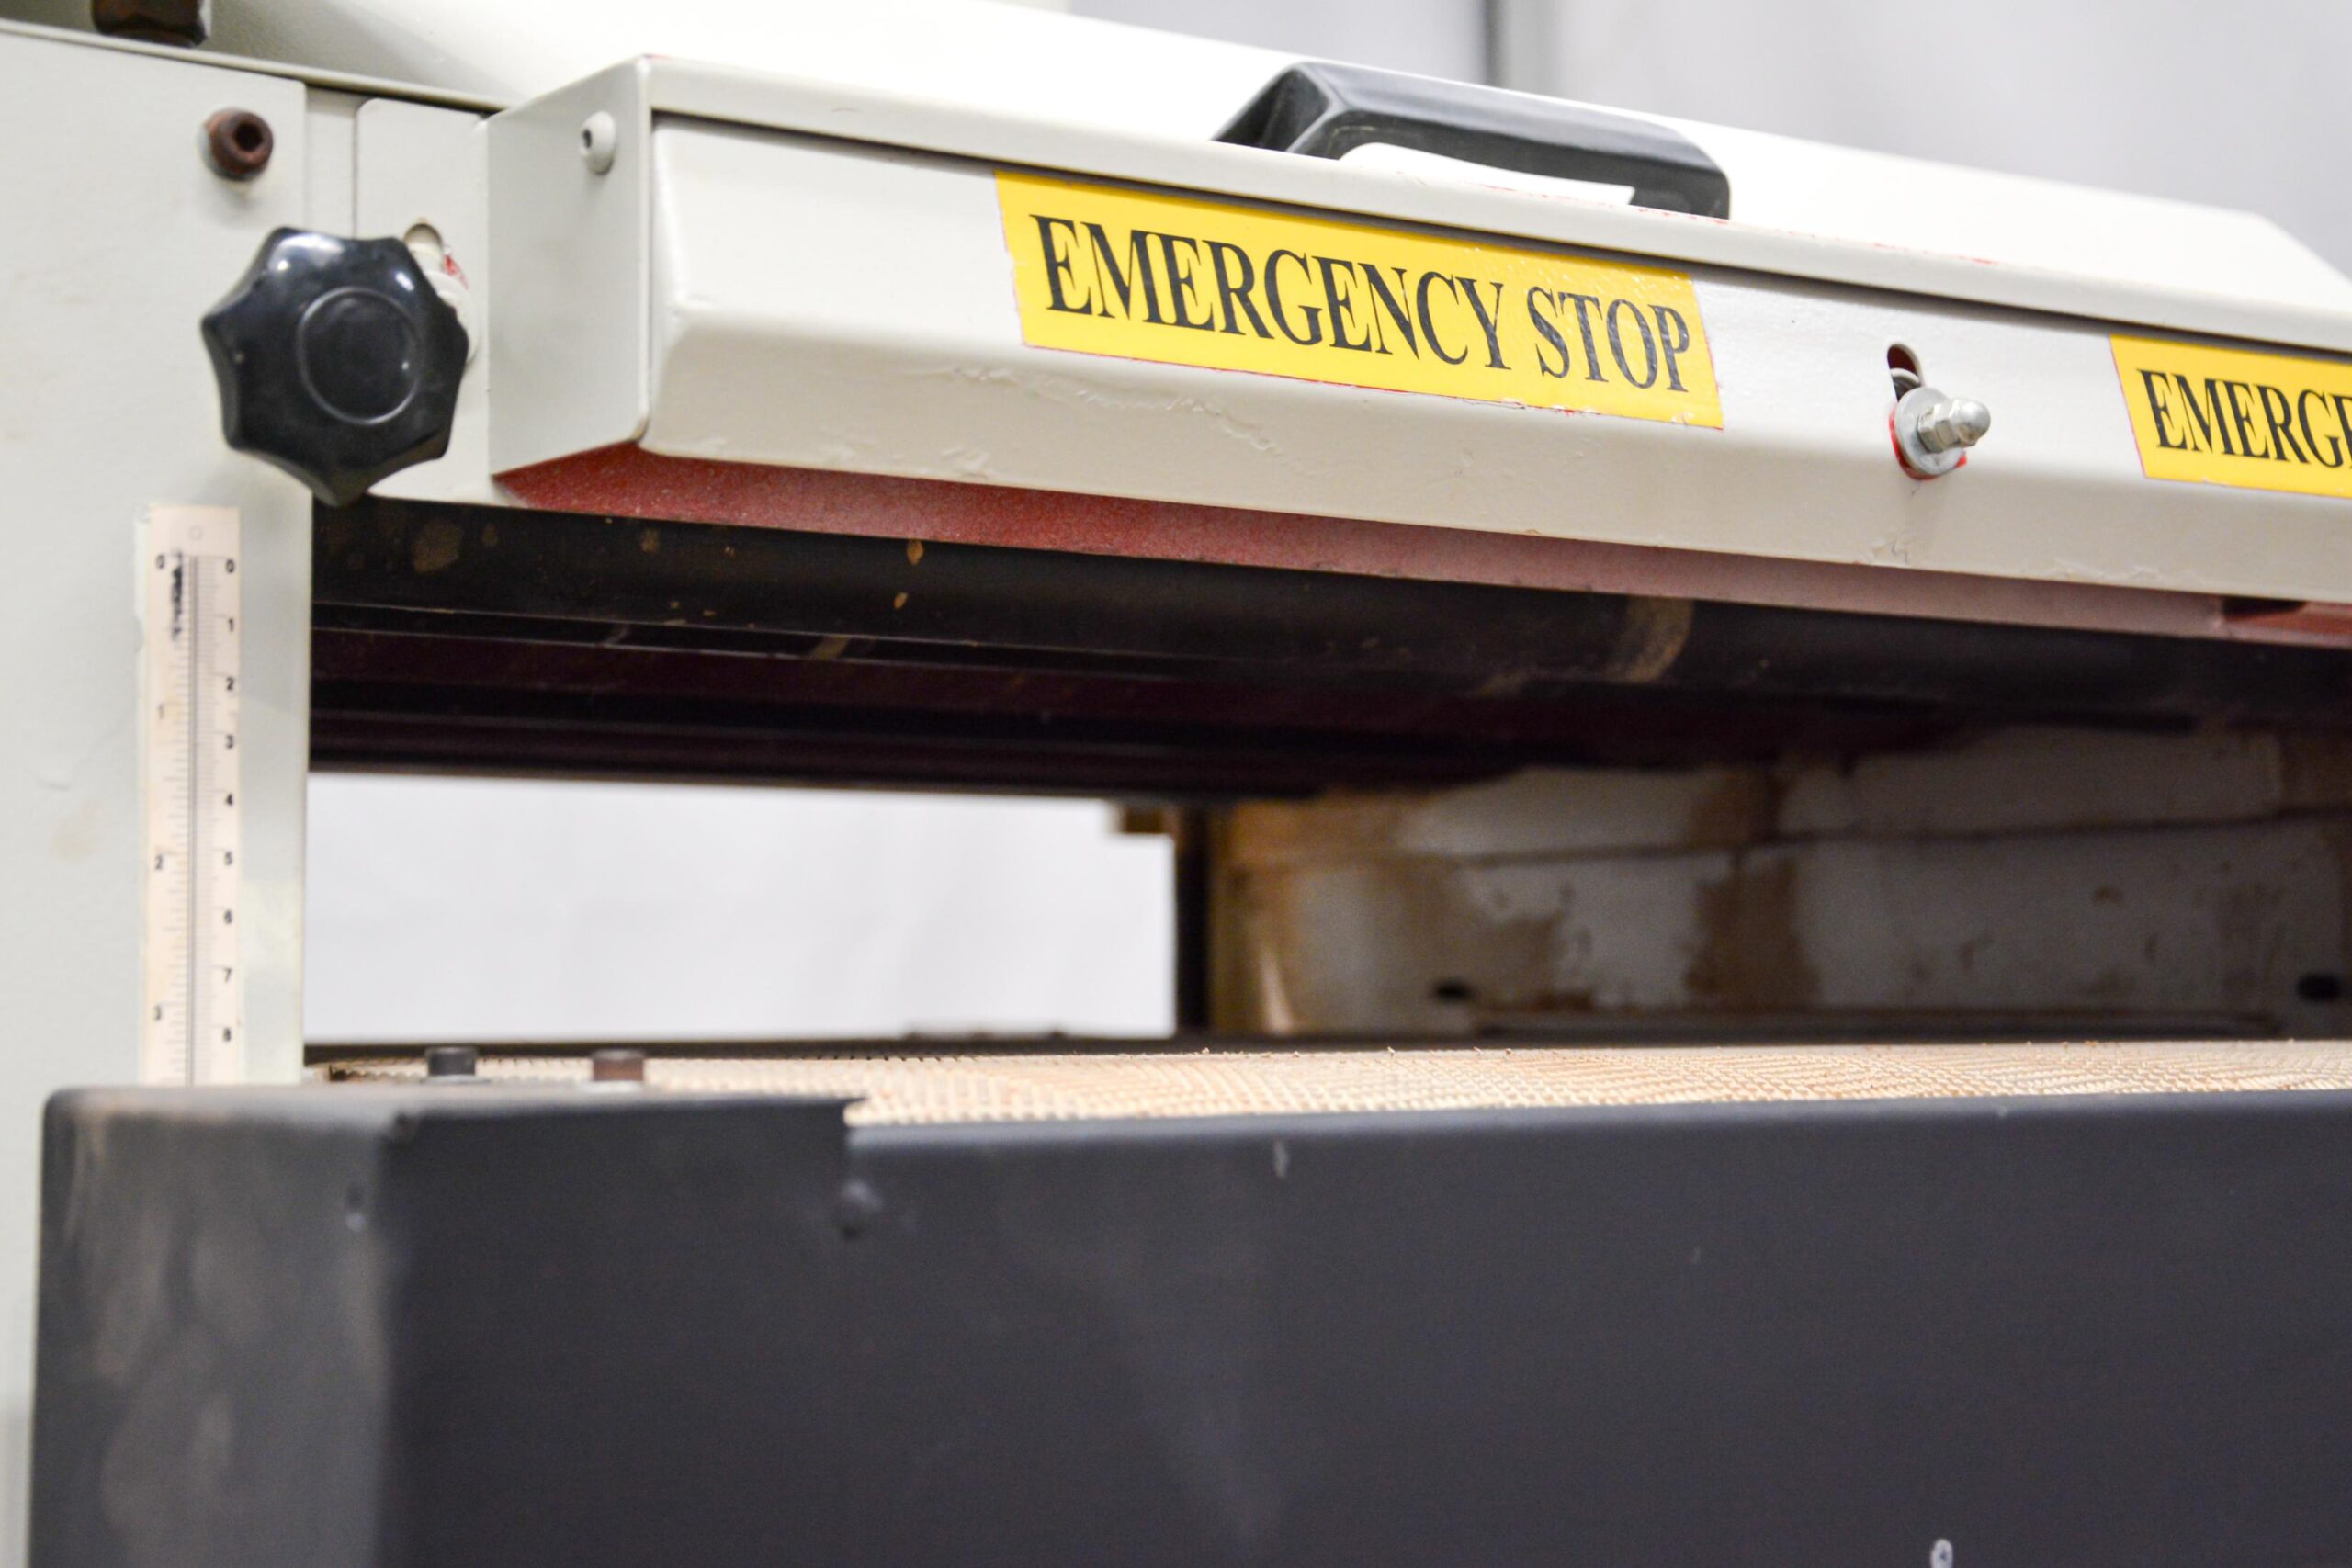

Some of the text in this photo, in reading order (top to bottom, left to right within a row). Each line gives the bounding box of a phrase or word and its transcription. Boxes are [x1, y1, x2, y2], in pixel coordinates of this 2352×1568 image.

[1029, 213, 1690, 393] EMERGENCY STOP
[225, 558, 235, 574] 0
[228, 617, 234, 633] 1
[225, 676, 234, 692] 2
[225, 734, 234, 750] 3
[225, 793, 234, 807] 4
[154, 852, 164, 870] 2
[224, 851, 233, 866] 5
[223, 909, 233, 925] 6
[224, 967, 232, 983] 7
[152, 1005, 163, 1022] 3
